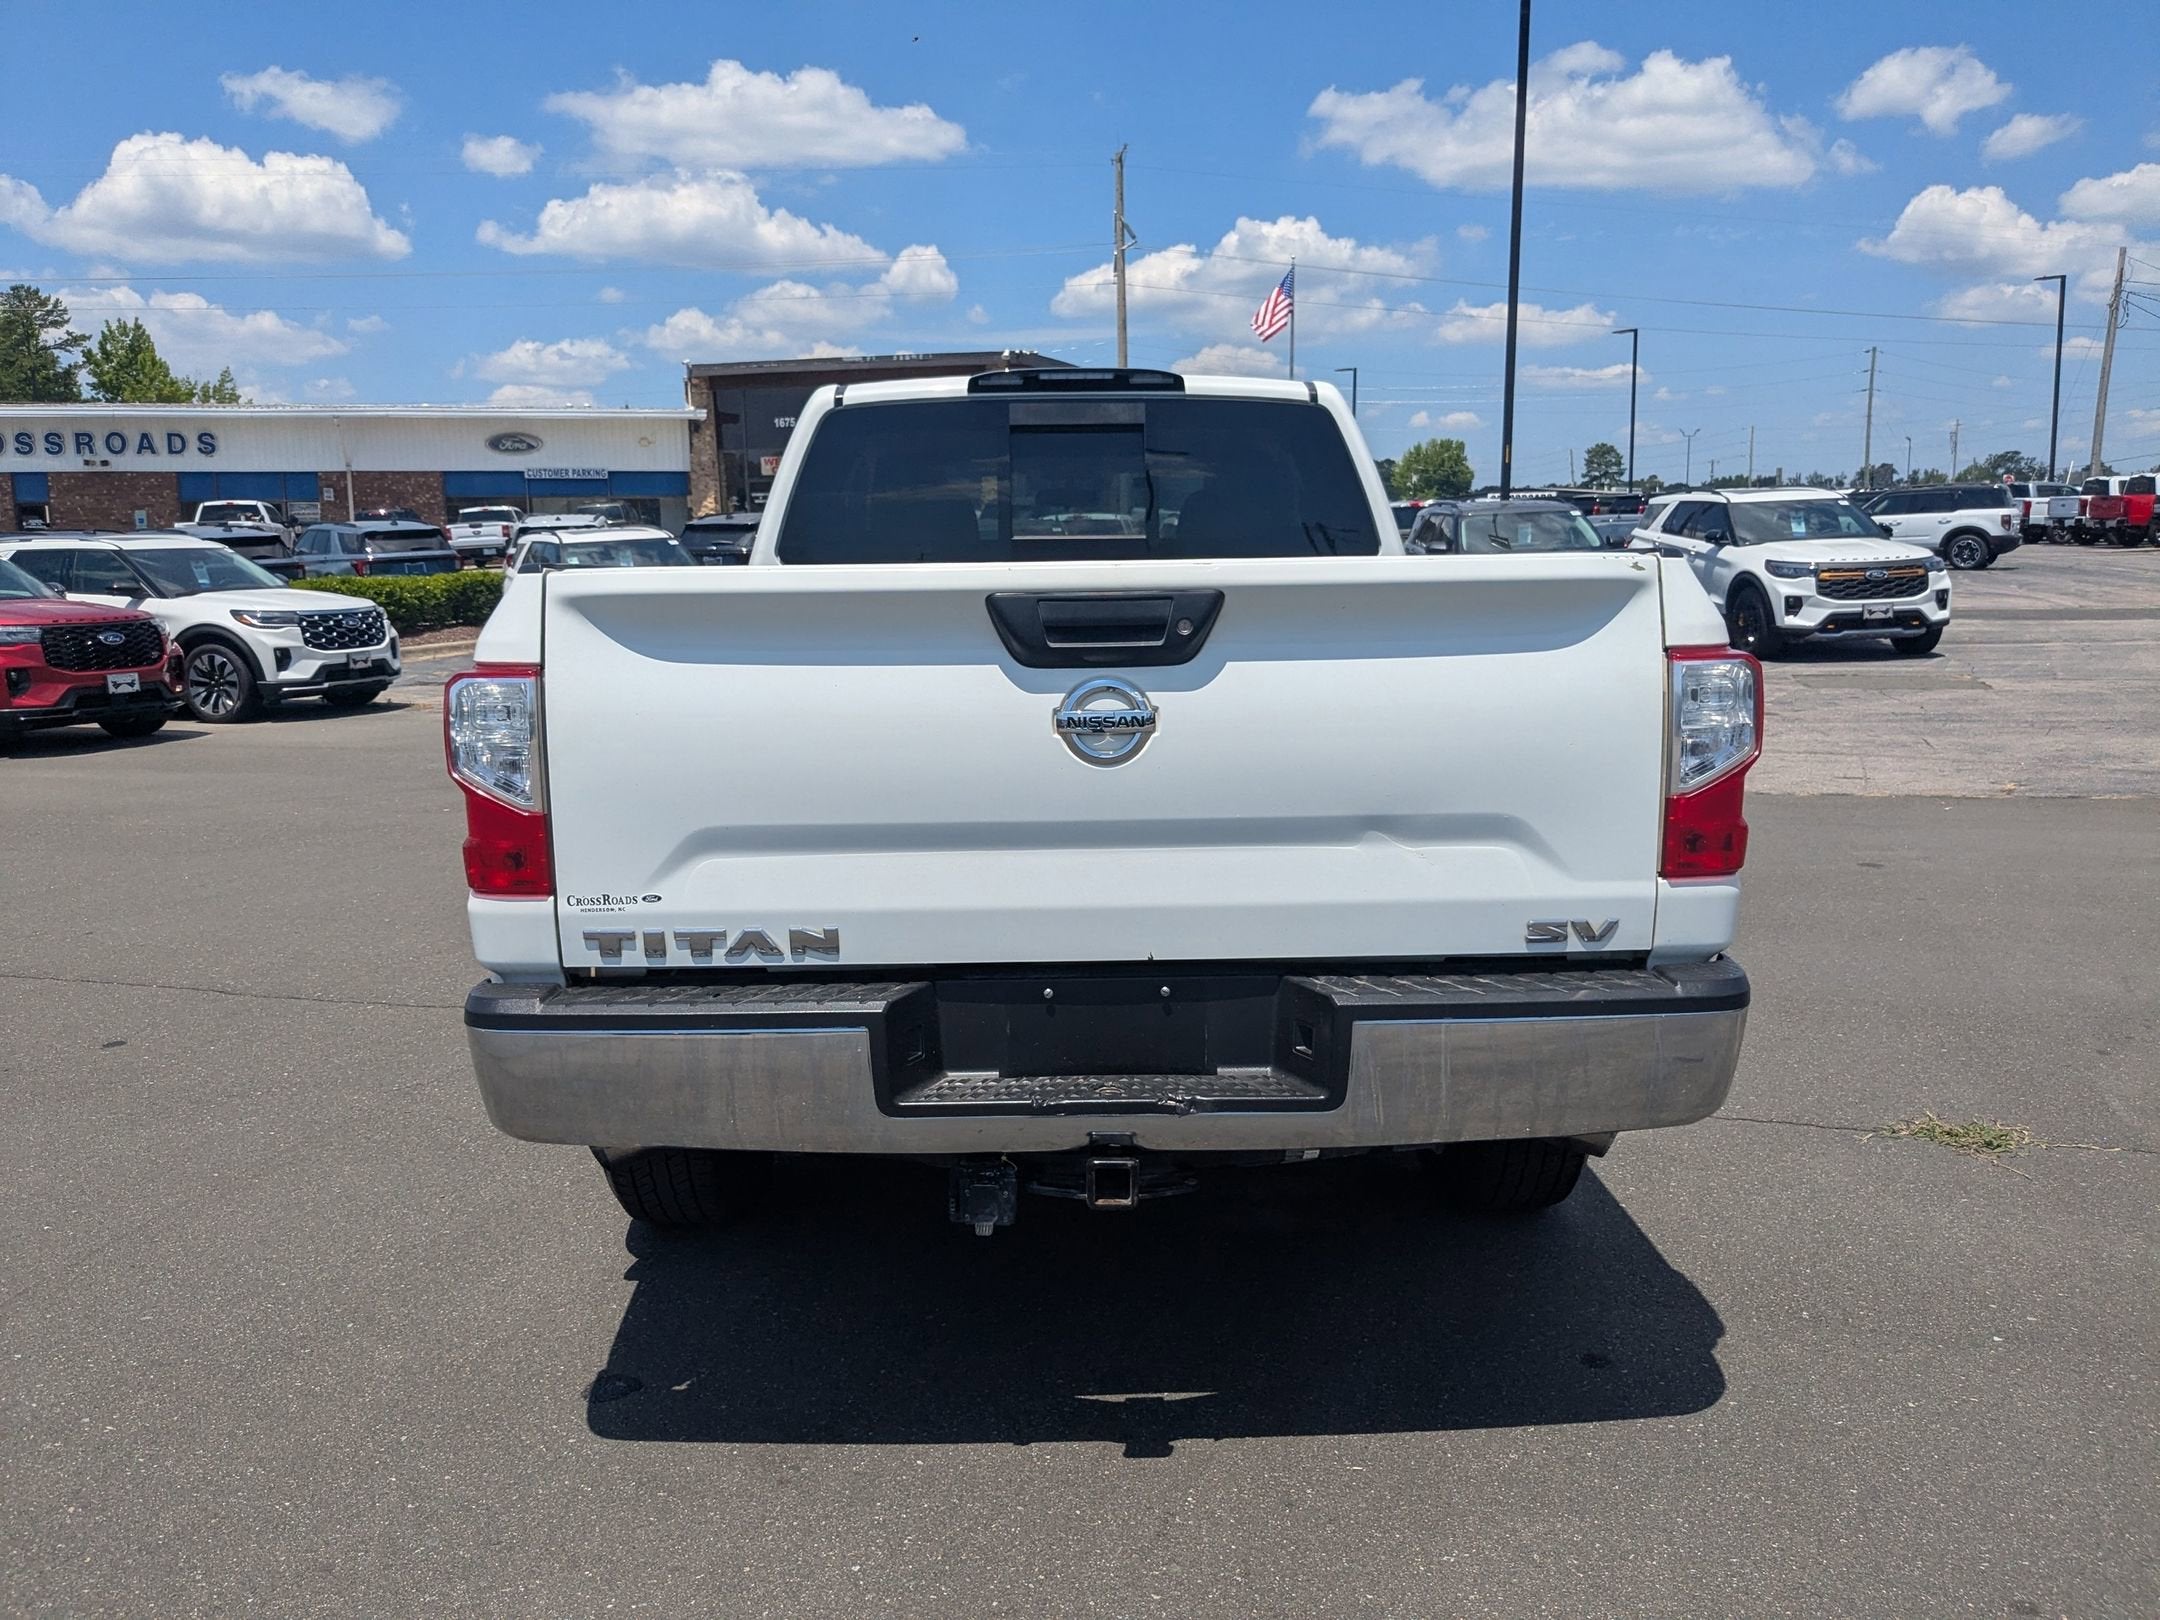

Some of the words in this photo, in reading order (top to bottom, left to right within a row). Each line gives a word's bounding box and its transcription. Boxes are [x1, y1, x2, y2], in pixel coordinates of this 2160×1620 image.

[774, 417, 797, 428] 1675
[0, 431, 217, 456] SSROADS
[526, 468, 570, 479] CUSTOMER
[572, 468, 607, 478] PARKING
[1066, 715, 1147, 730] NISSAN
[1526, 919, 1620, 943] SV
[583, 926, 840, 959] TITAN
